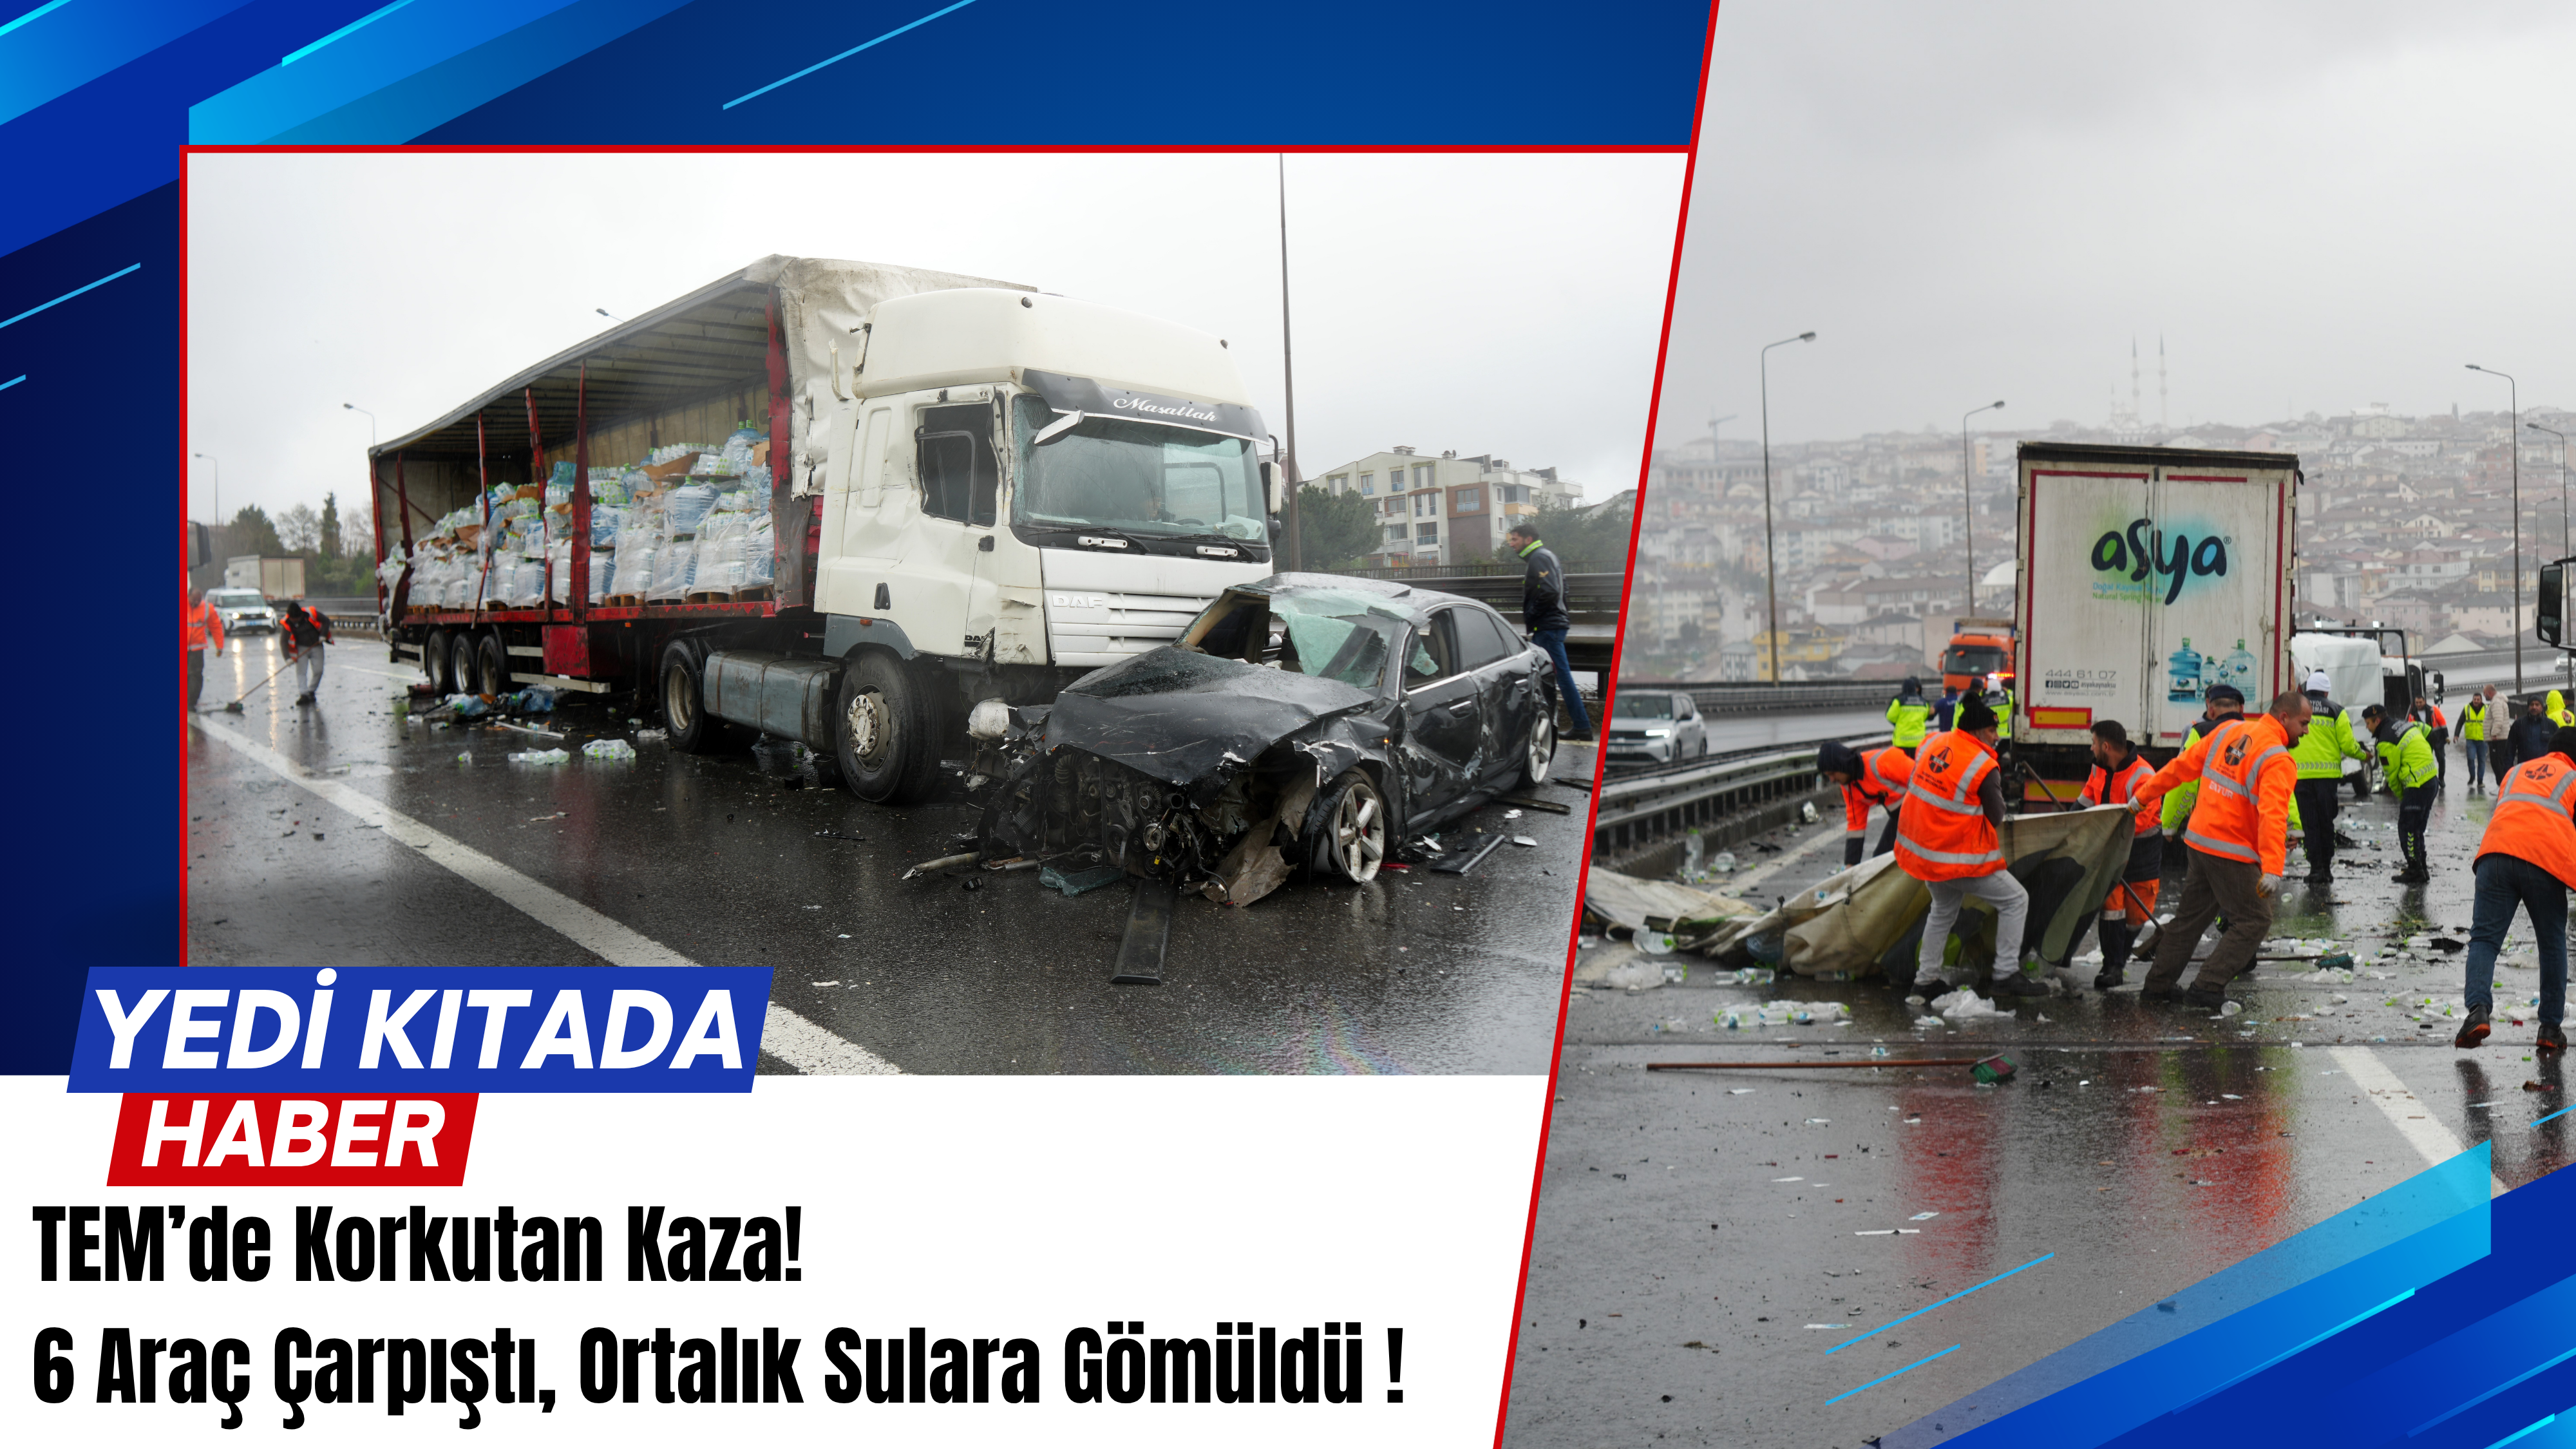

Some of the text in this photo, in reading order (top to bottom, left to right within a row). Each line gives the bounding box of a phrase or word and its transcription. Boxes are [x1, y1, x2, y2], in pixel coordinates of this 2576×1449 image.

[2091, 518, 2227, 605] asya
[1052, 595, 1103, 609] DAF
[2092, 592, 2118, 600] Natural
[2119, 593, 2142, 603] Spring
[2045, 669, 2116, 679] 444 61 07
